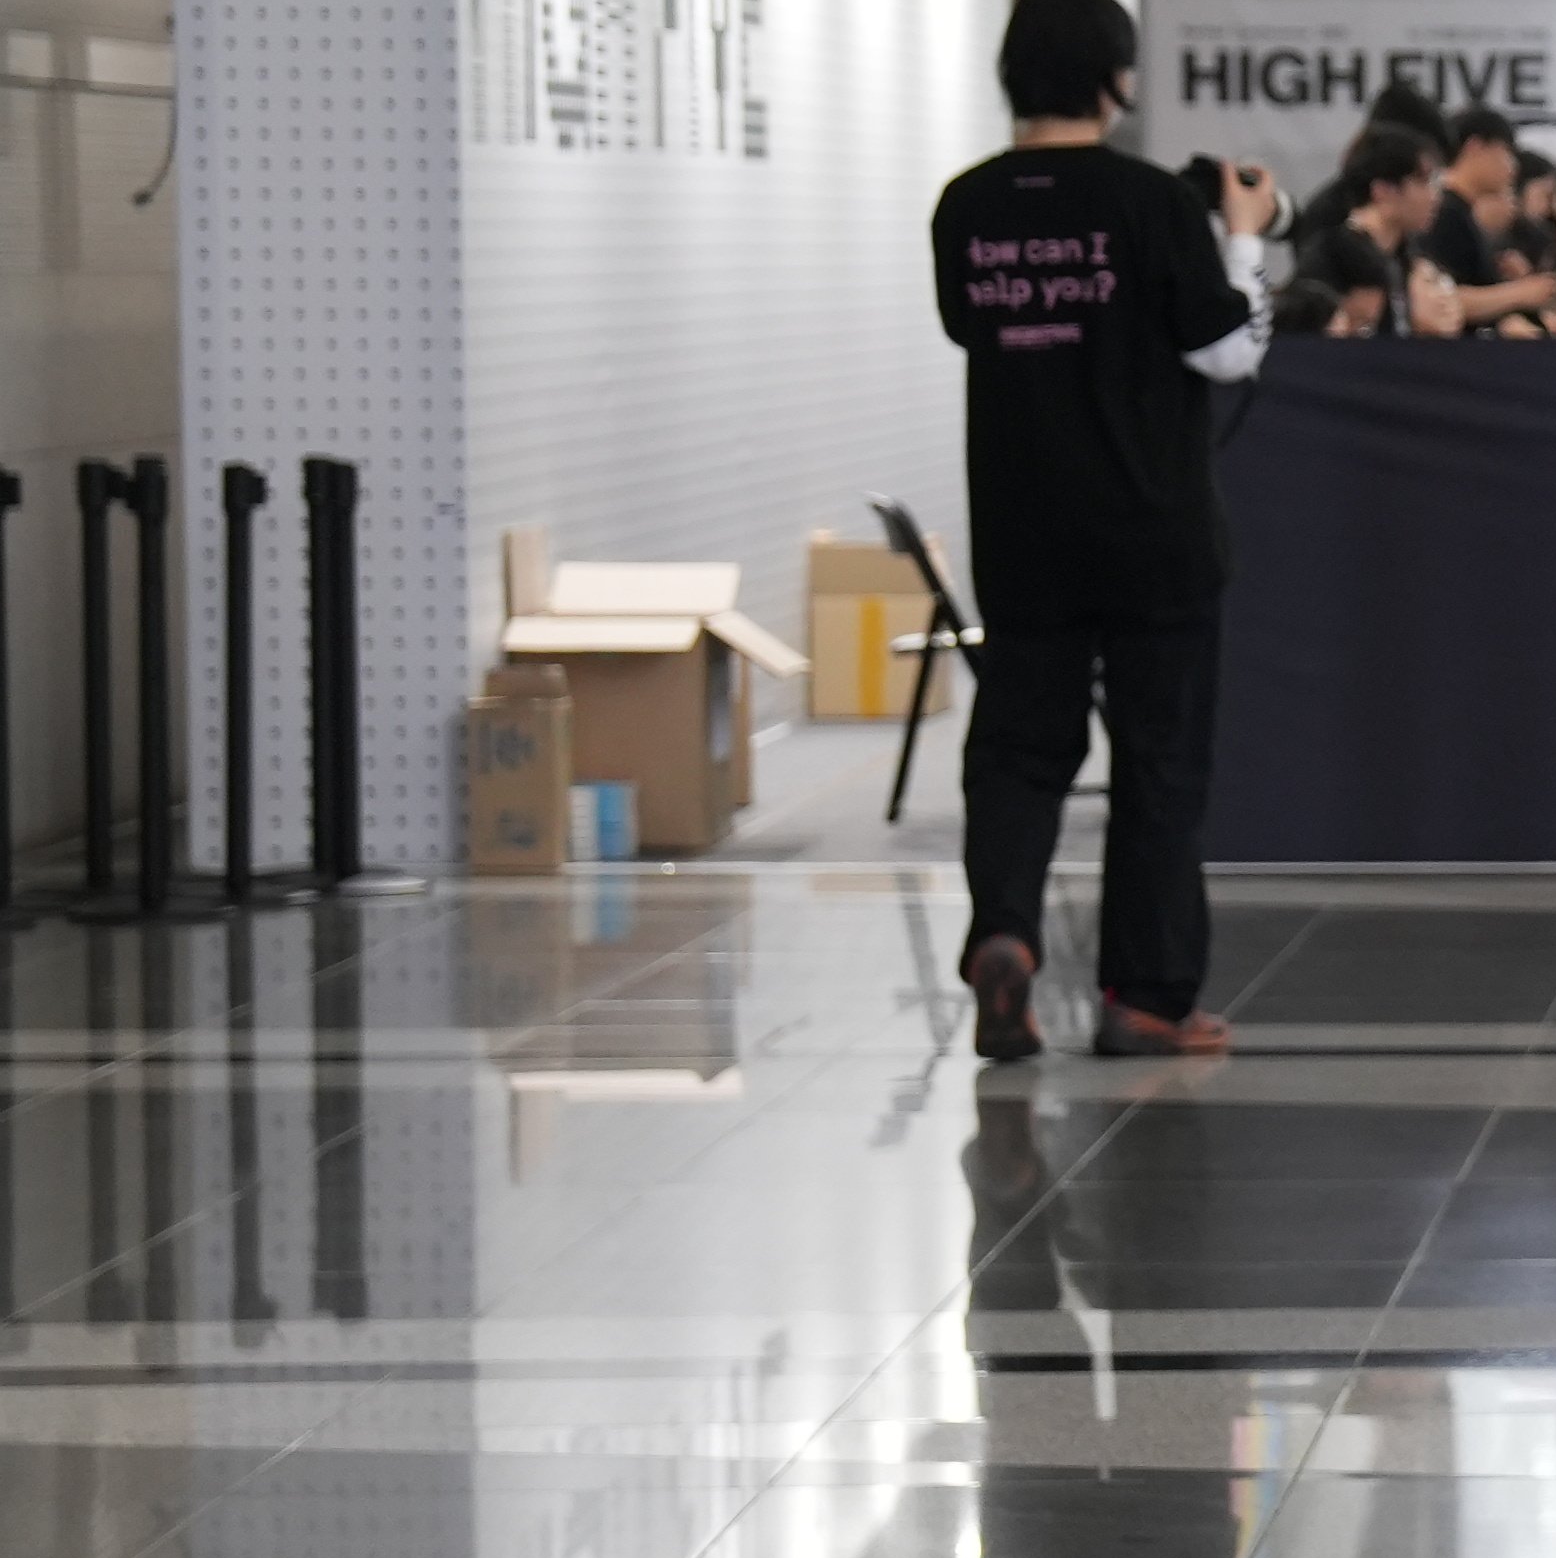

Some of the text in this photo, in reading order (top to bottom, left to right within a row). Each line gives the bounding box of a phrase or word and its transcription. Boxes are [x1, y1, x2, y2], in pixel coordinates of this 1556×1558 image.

[1181, 47, 1547, 106] HIGH FIVE
[1024, 239, 1083, 265] can
